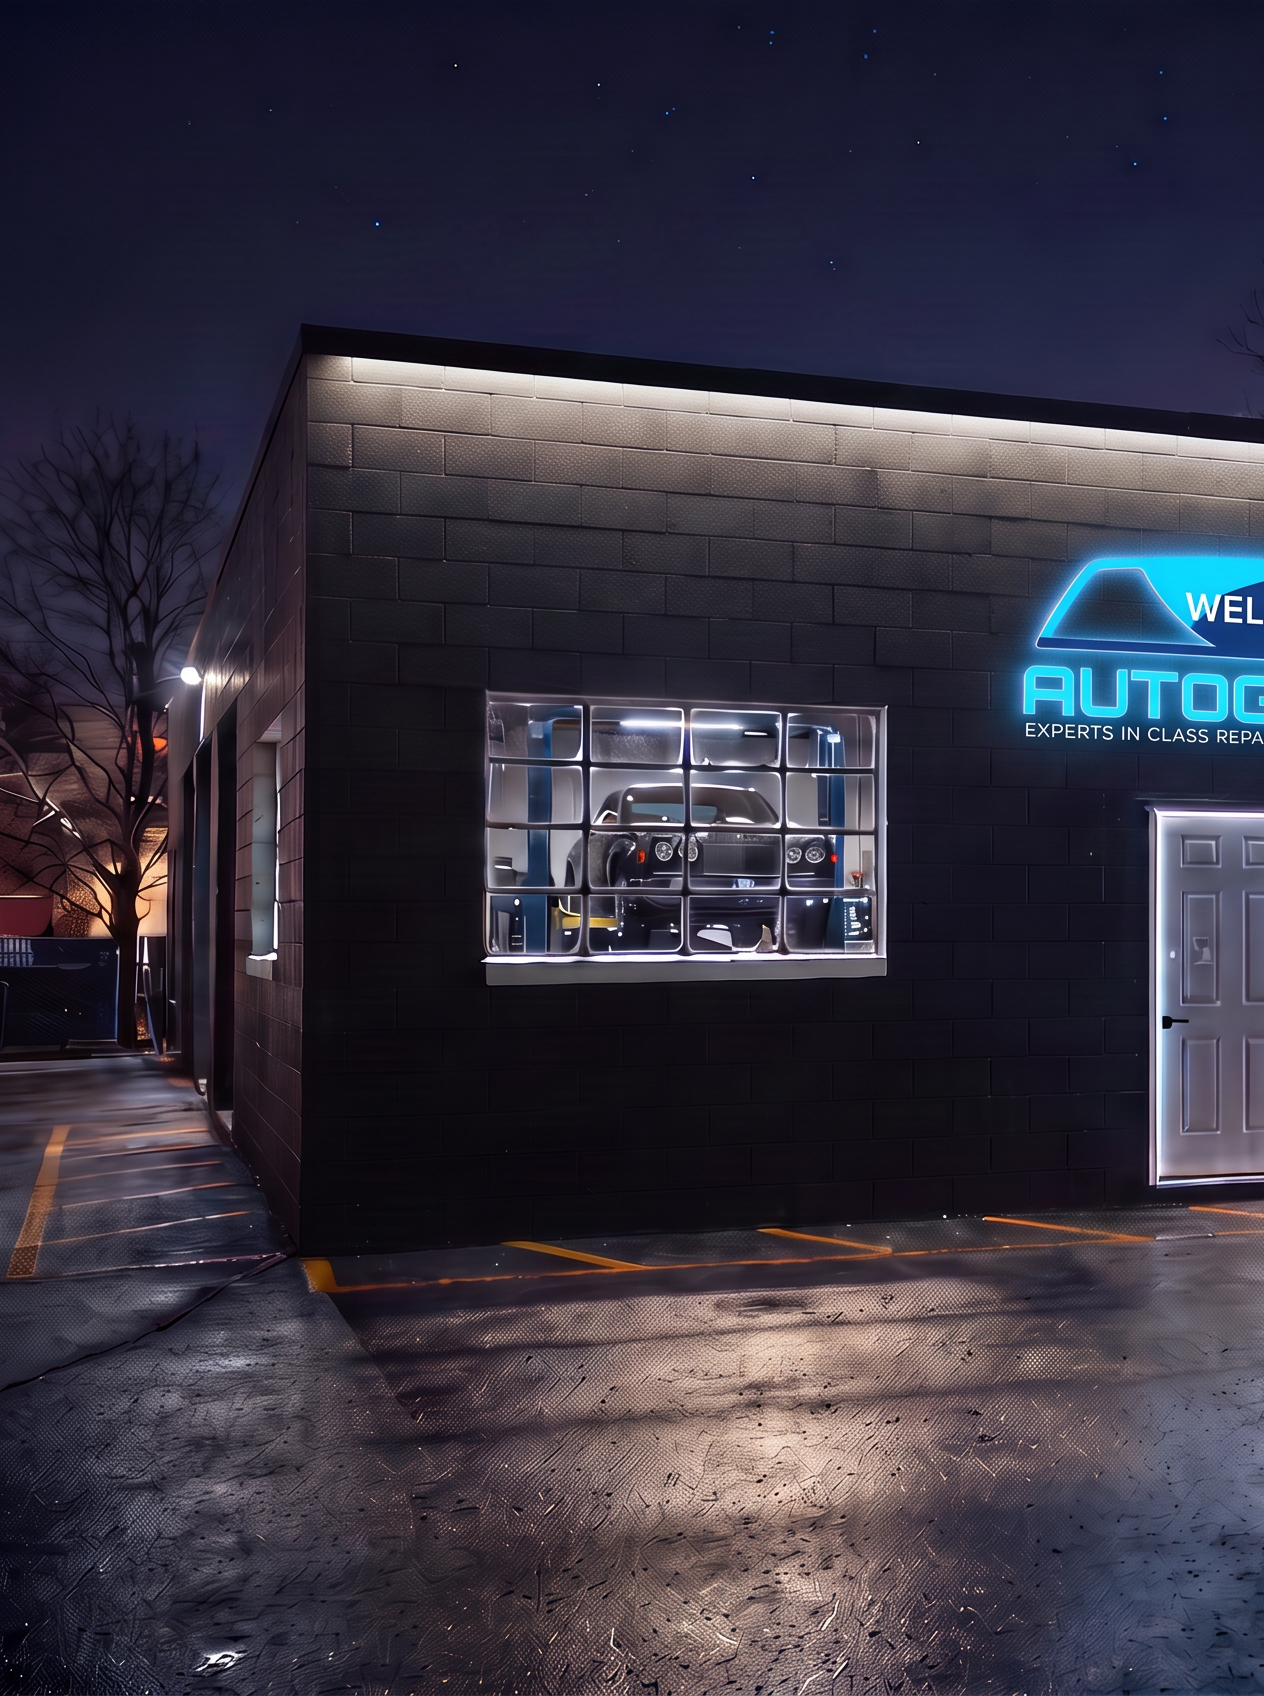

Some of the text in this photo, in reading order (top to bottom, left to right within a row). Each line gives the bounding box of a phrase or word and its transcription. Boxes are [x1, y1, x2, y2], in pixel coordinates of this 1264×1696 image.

[1025, 722, 1114, 741] EXPERTS
[1121, 726, 1140, 741] IN
[1147, 727, 1209, 744] CLASS
